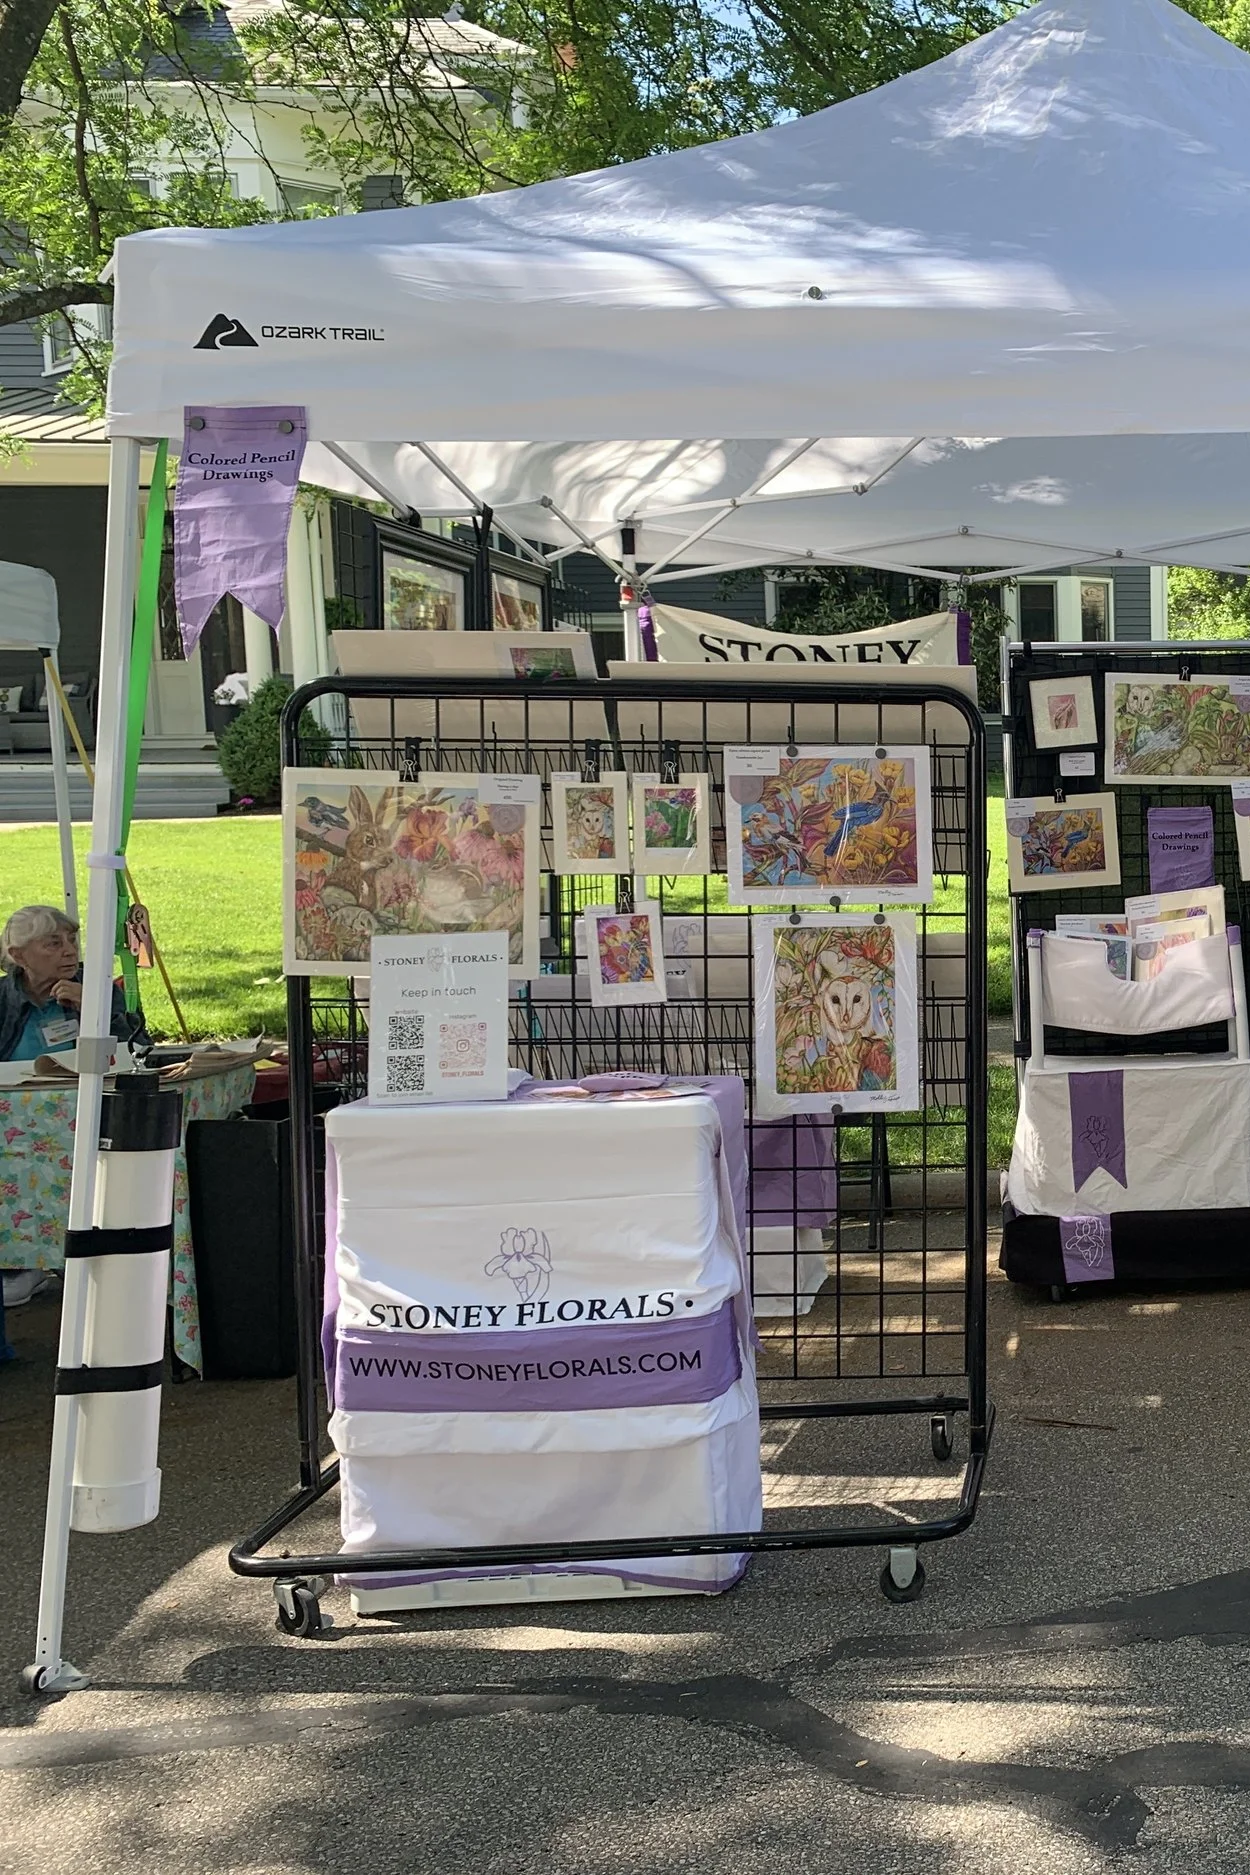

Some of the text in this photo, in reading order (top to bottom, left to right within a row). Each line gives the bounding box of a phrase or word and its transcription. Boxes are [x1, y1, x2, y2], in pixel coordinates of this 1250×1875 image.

[261, 325, 326, 340] OZARK
[187, 449, 296, 465] Colored Pencil
[202, 468, 274, 482] Drawings
[1151, 830, 1209, 840] Colored Pencil
[1161, 843, 1200, 853] Drawings
[383, 953, 498, 967] STONEY FLORALS
[400, 986, 477, 999] Keep in touch
[366, 1291, 675, 1330] STONEY FLORALS
[348, 1349, 702, 1382] WWW.STONEYFLORALS.COM
